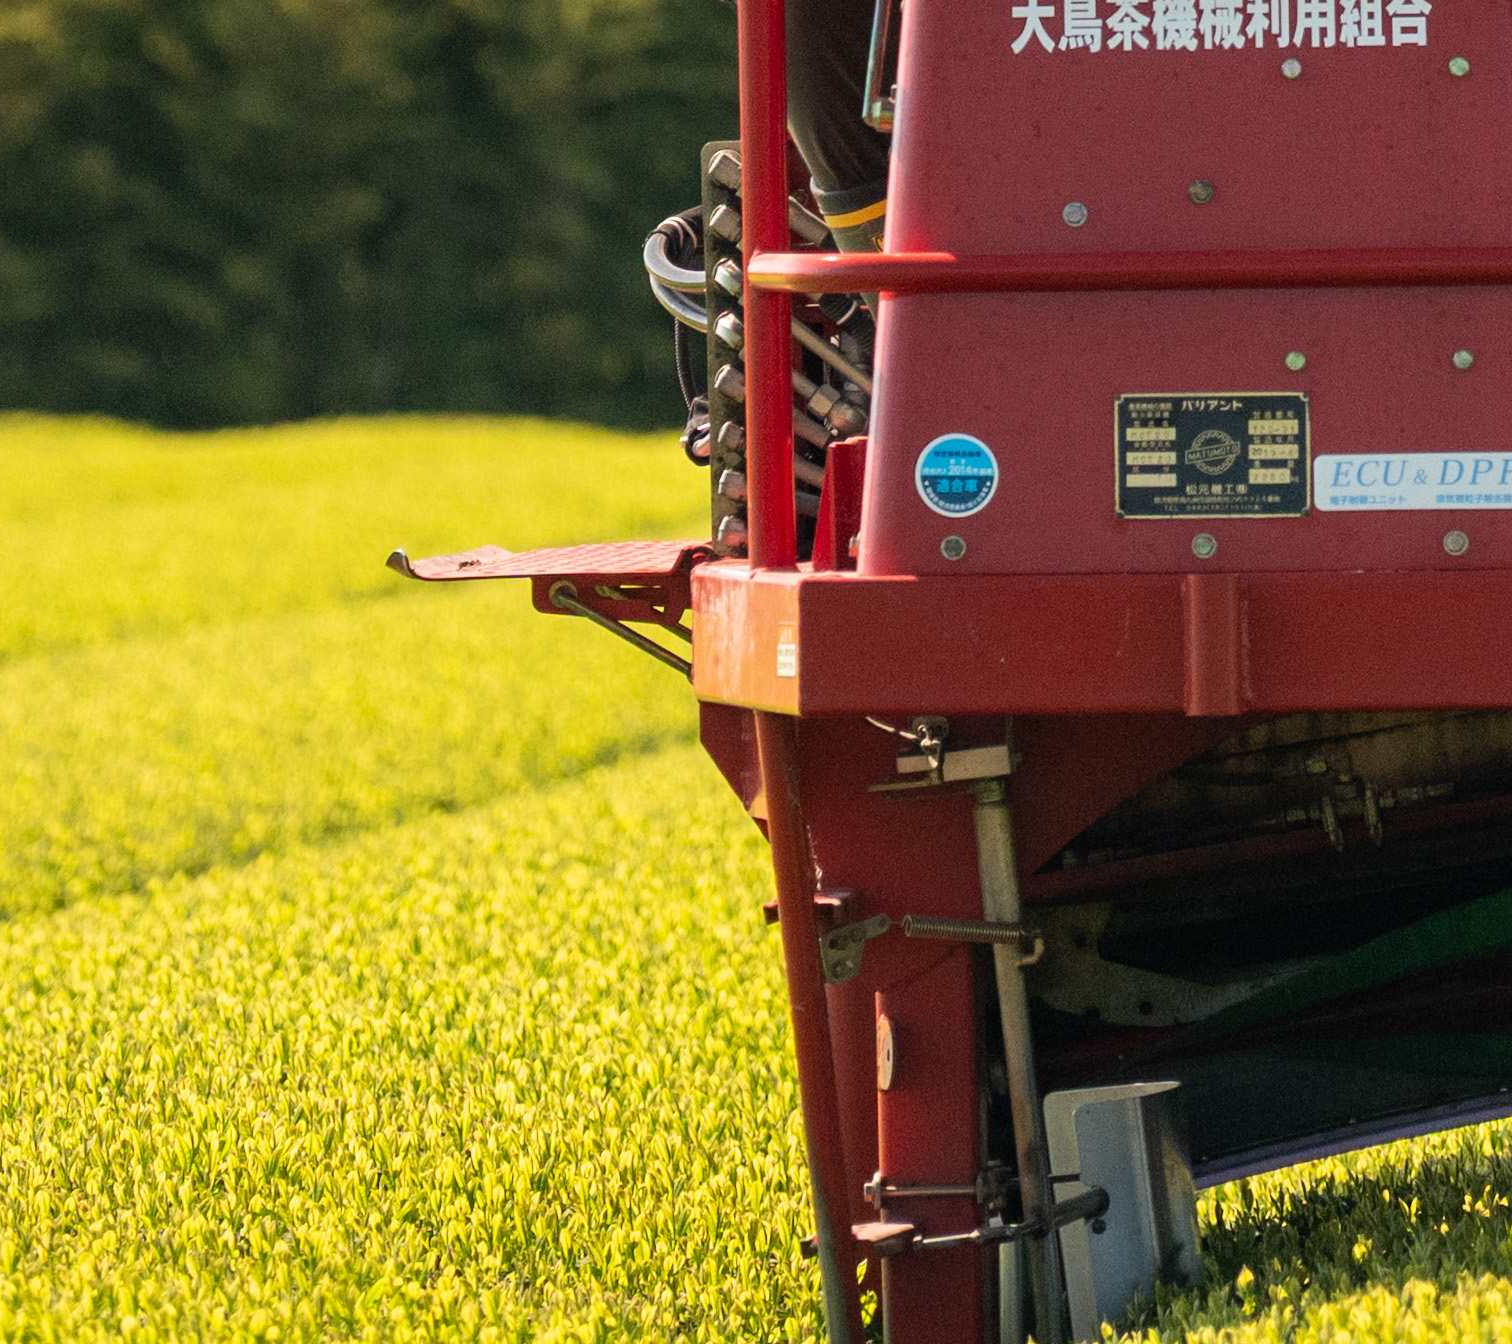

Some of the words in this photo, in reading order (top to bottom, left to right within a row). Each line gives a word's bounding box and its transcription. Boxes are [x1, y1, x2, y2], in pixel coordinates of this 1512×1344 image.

[1181, 399, 1243, 412] バリアント
[1330, 460, 1408, 487] ECU
[1413, 469, 1428, 485] &
